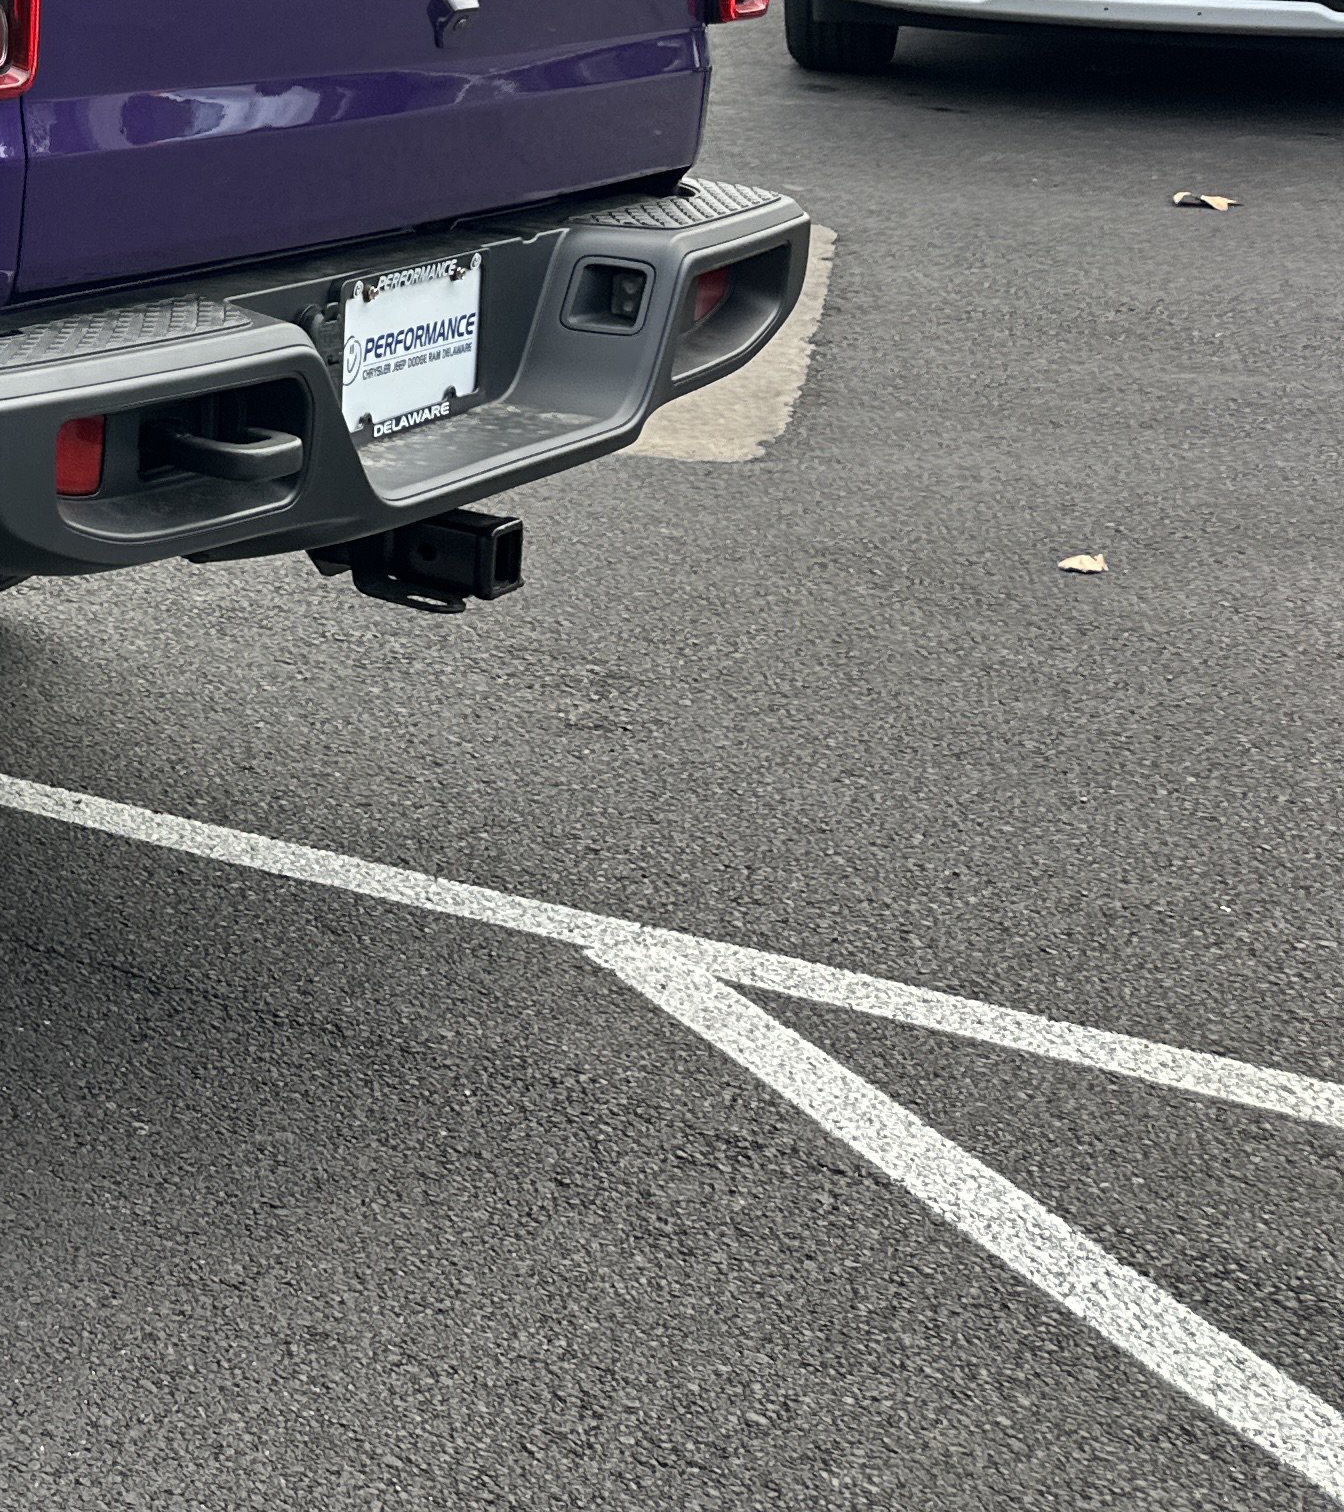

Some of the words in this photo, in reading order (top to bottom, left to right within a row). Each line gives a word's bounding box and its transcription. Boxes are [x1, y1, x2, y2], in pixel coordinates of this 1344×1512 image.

[376, 259, 458, 292] PERFORMANCE
[363, 312, 476, 363] PERFORMANCE
[362, 363, 391, 381] CHRYSLER
[391, 359, 407, 373] JEEP
[407, 353, 428, 369] DODGE
[428, 349, 441, 363] RAM
[442, 341, 473, 359] DELAWARE
[373, 401, 450, 437] DELAWARE
